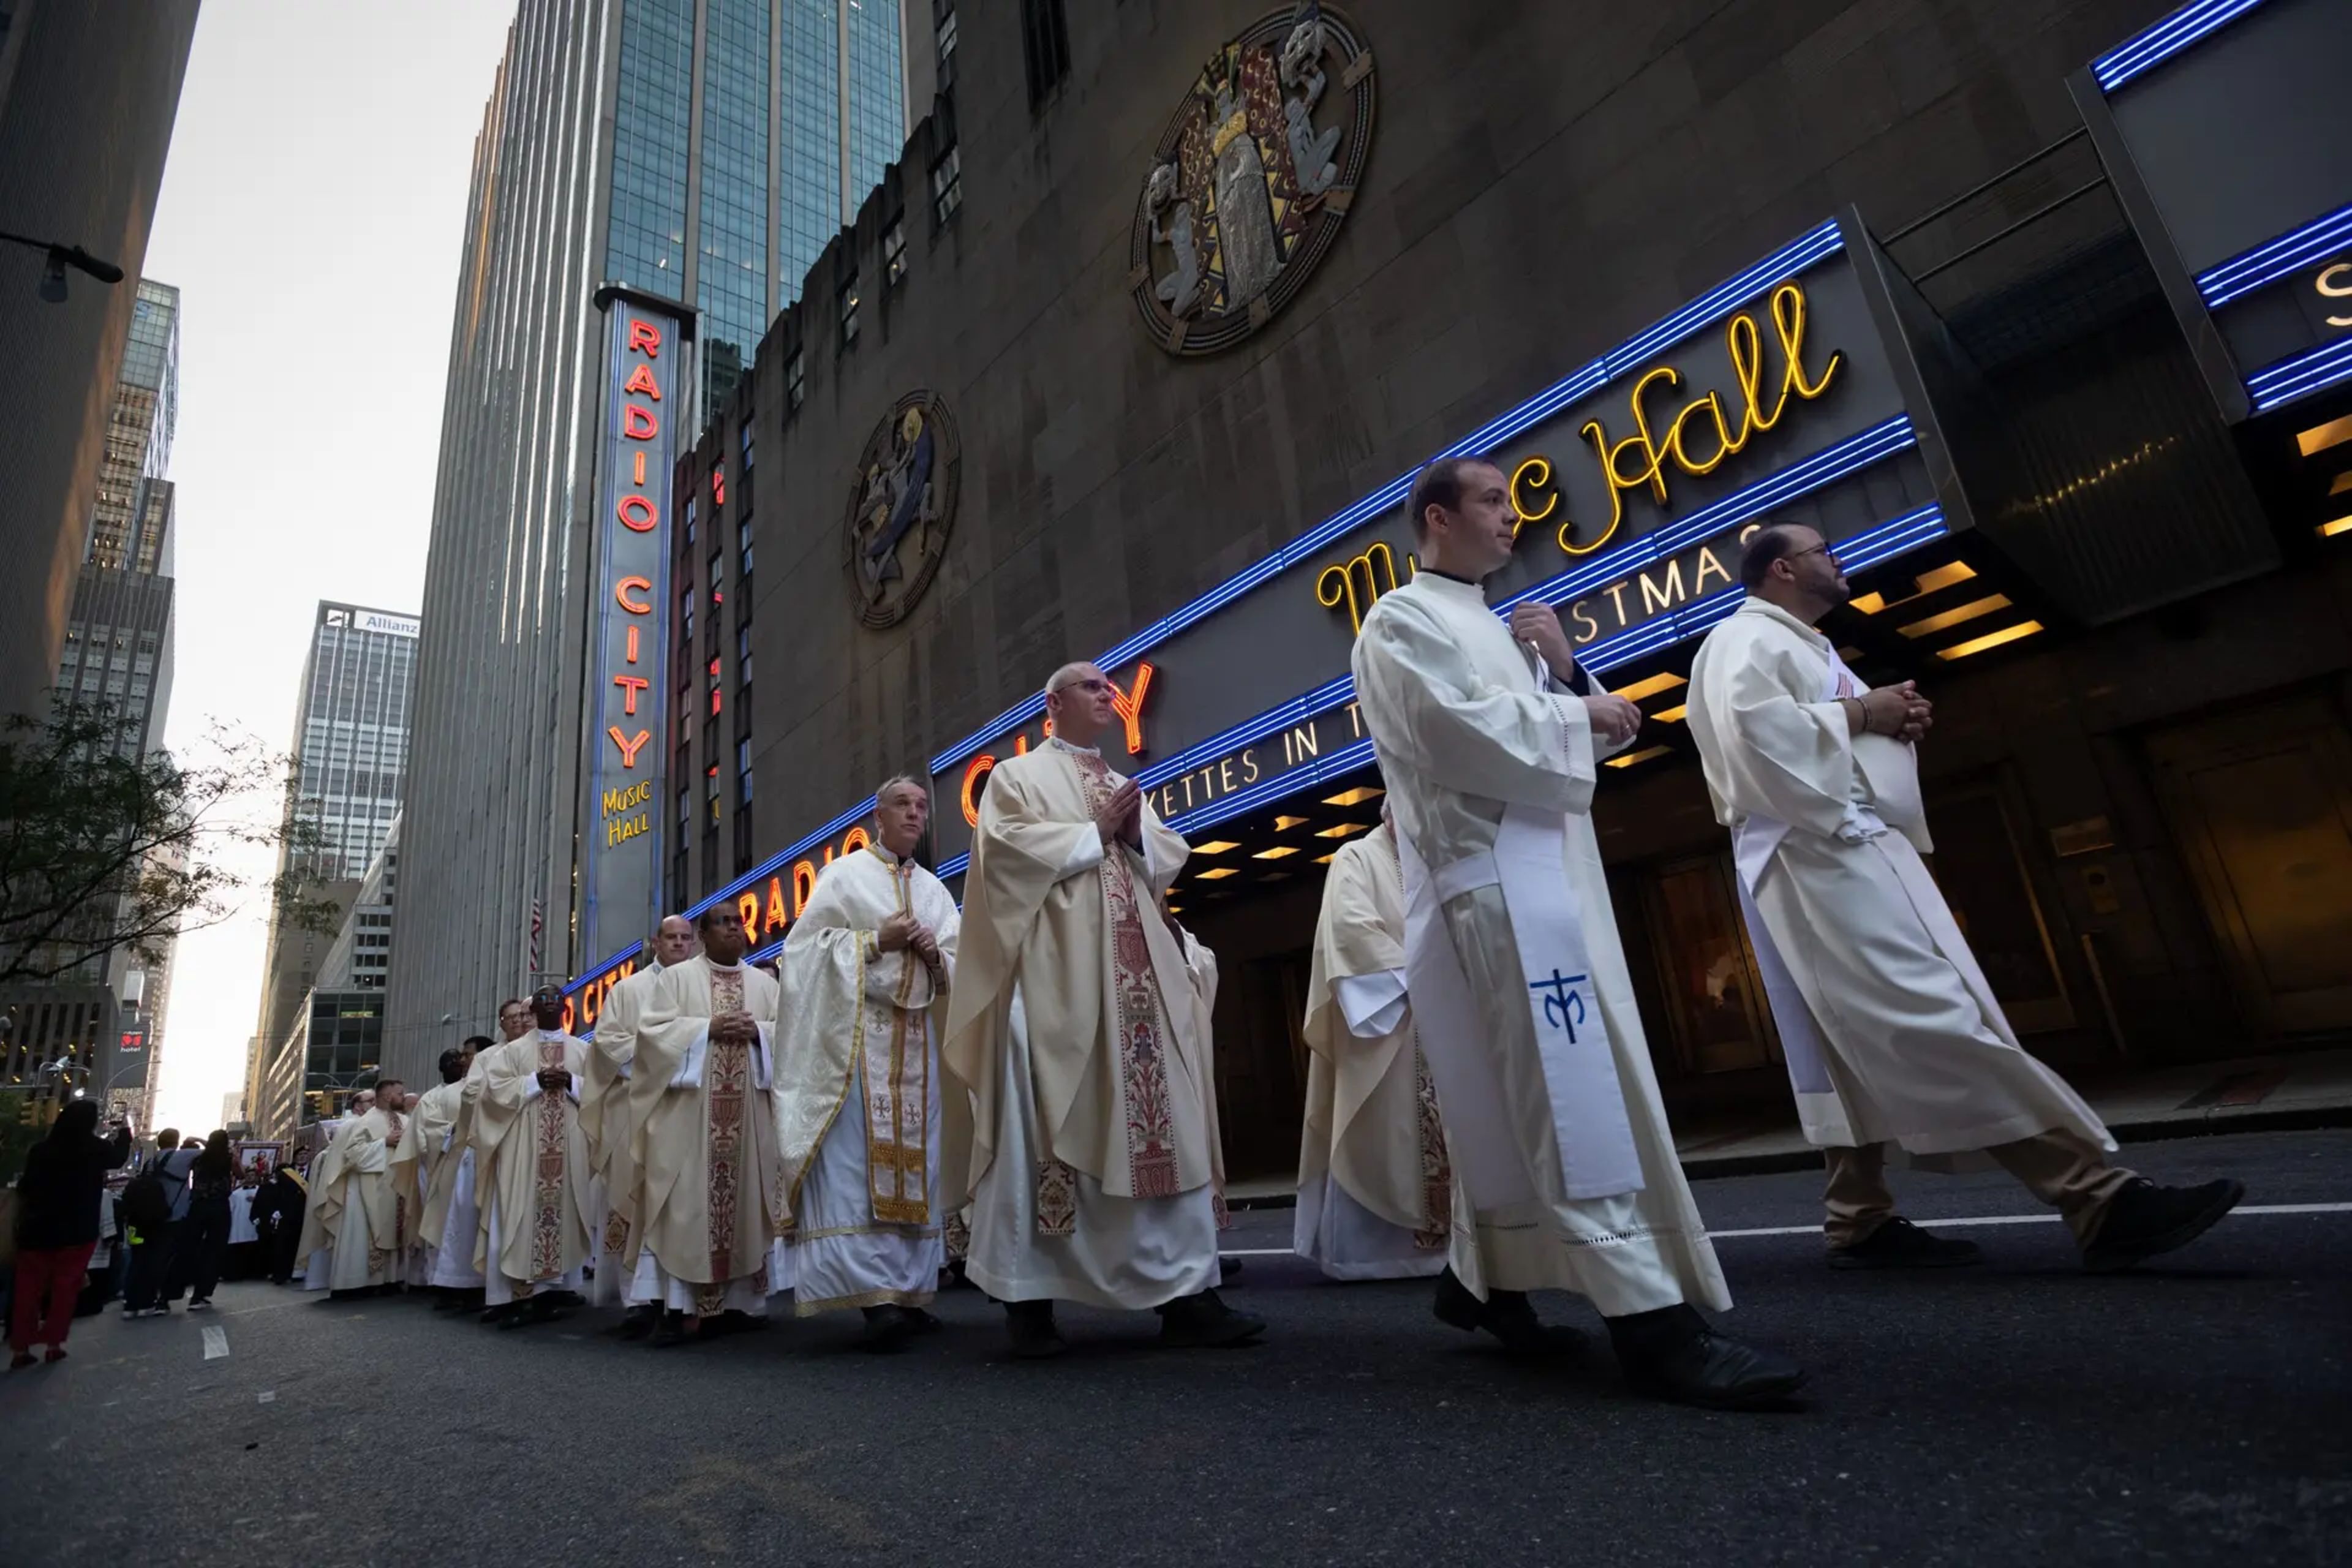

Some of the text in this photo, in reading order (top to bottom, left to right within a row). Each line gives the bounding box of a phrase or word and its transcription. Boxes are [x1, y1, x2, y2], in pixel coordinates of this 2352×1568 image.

[1556, 284, 1841, 556] Hall
[608, 319, 662, 769] RADIO CITY
[366, 616, 418, 633] Allianz
[1284, 722, 1318, 766] IN
[739, 827, 871, 944] RAD
